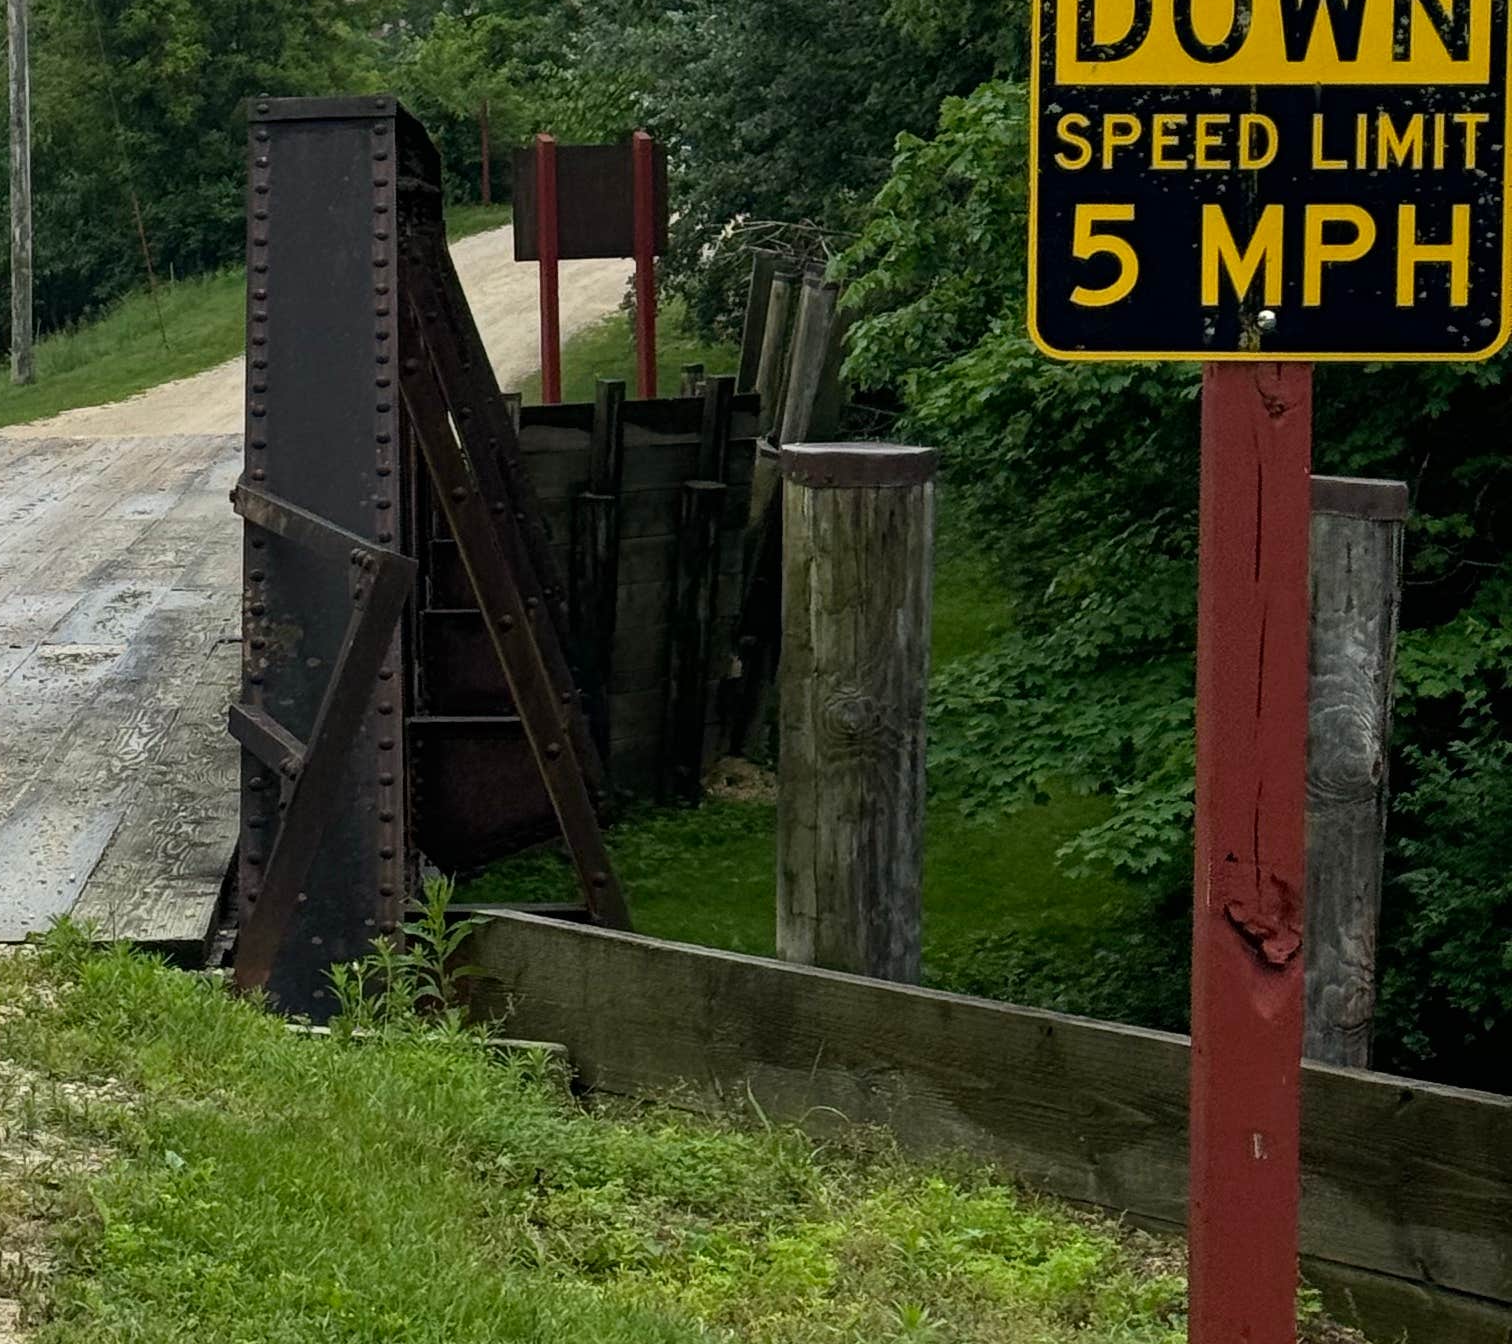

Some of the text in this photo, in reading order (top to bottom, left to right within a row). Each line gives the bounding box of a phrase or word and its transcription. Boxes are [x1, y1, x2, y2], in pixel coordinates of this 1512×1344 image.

[1054, 112, 1489, 171] SPEED LIMIT
[1069, 203, 1471, 309] 5 MPH
